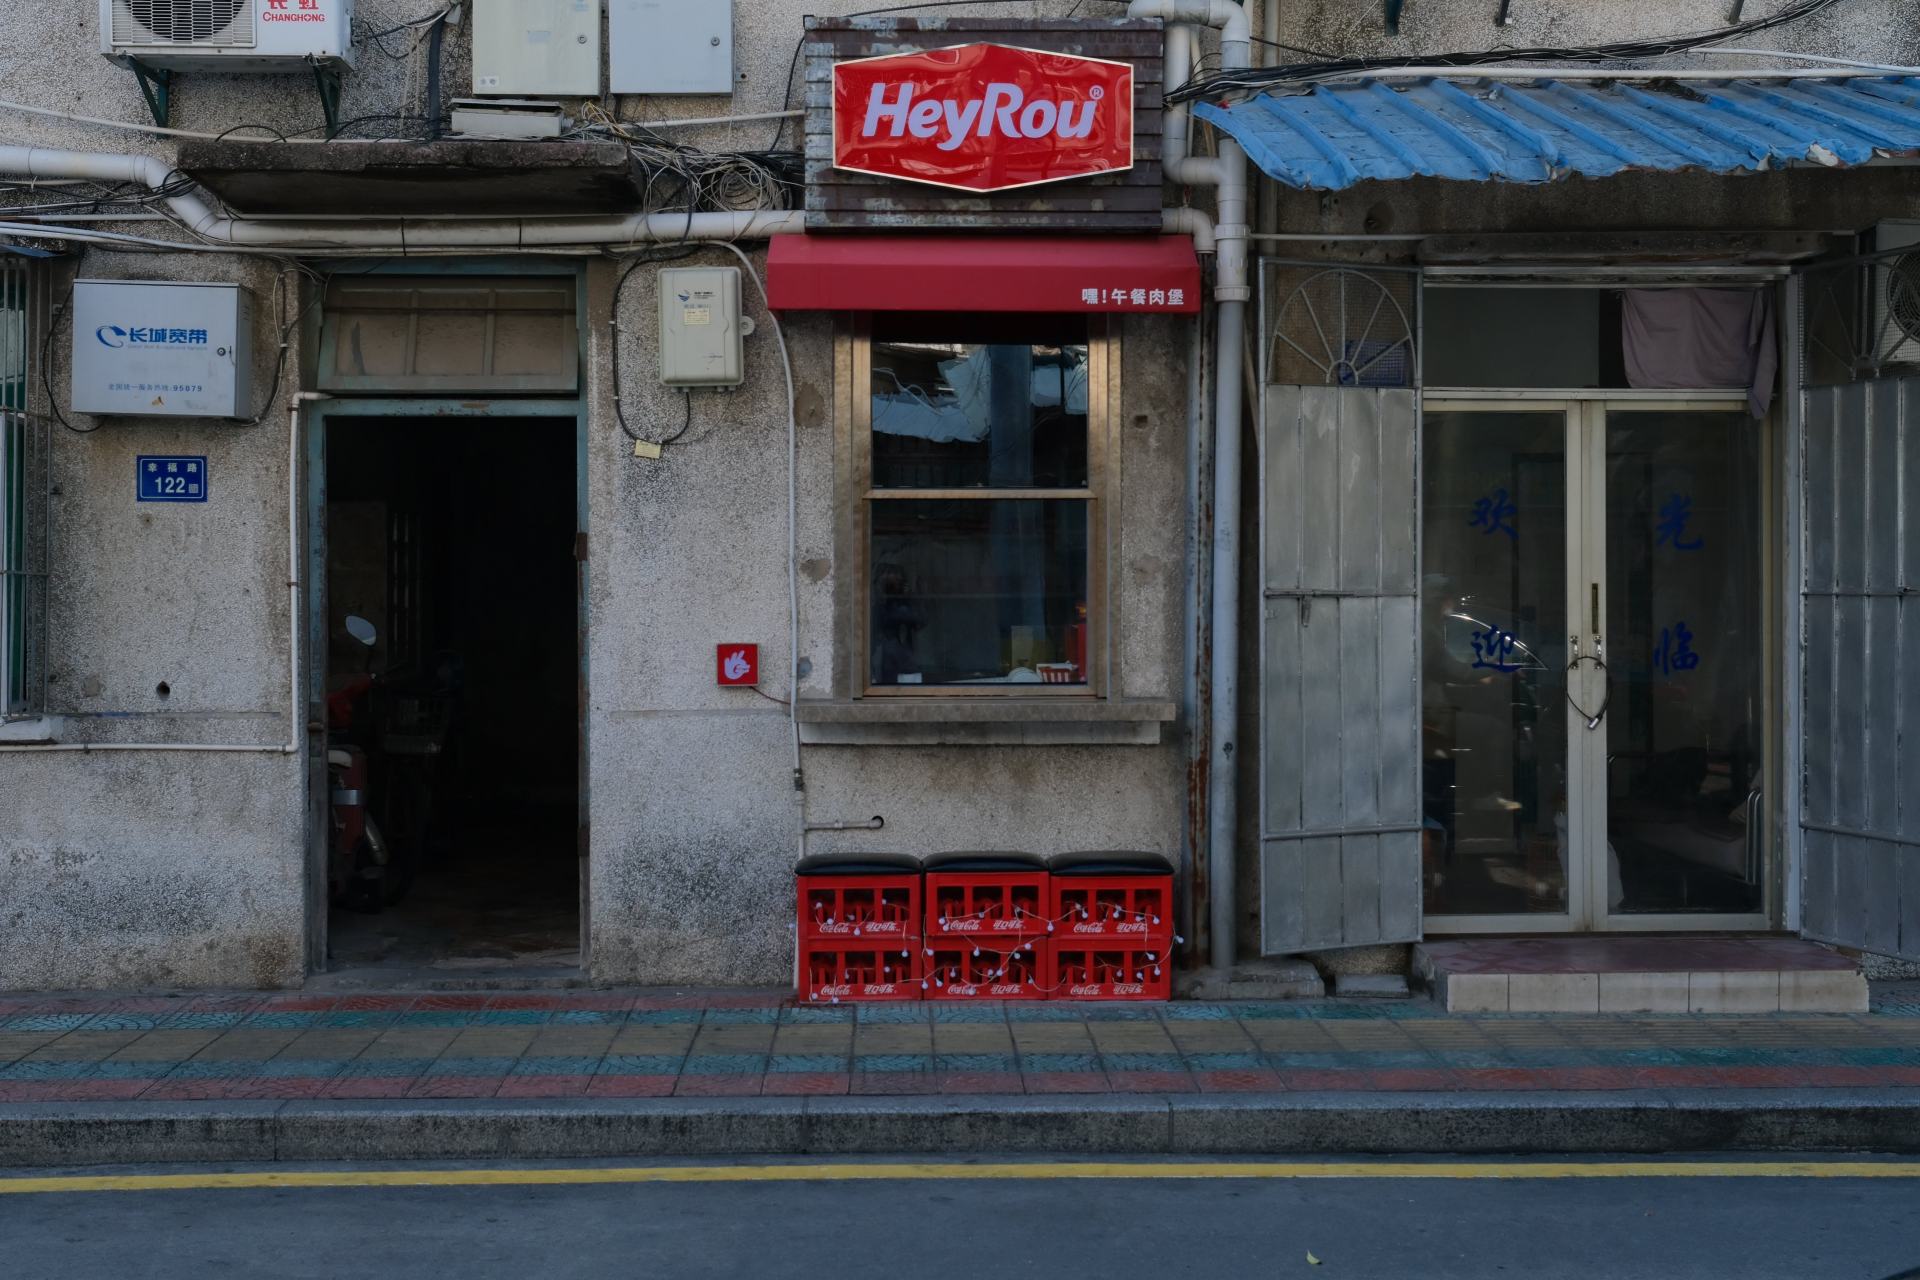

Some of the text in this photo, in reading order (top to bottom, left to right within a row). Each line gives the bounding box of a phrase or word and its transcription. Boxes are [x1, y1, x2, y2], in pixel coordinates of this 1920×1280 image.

[262, 12, 326, 22] CHANGHONG
[861, 82, 1097, 151] HeyRou
[129, 327, 208, 344] 长城宽带
[147, 462, 198, 473] 幸福路
[820, 922, 851, 934] Coca-Cola
[950, 919, 981, 931] Coca-Cola
[1074, 922, 1105, 933] Coca-Cola
[1071, 984, 1102, 995] Coca-Cola
